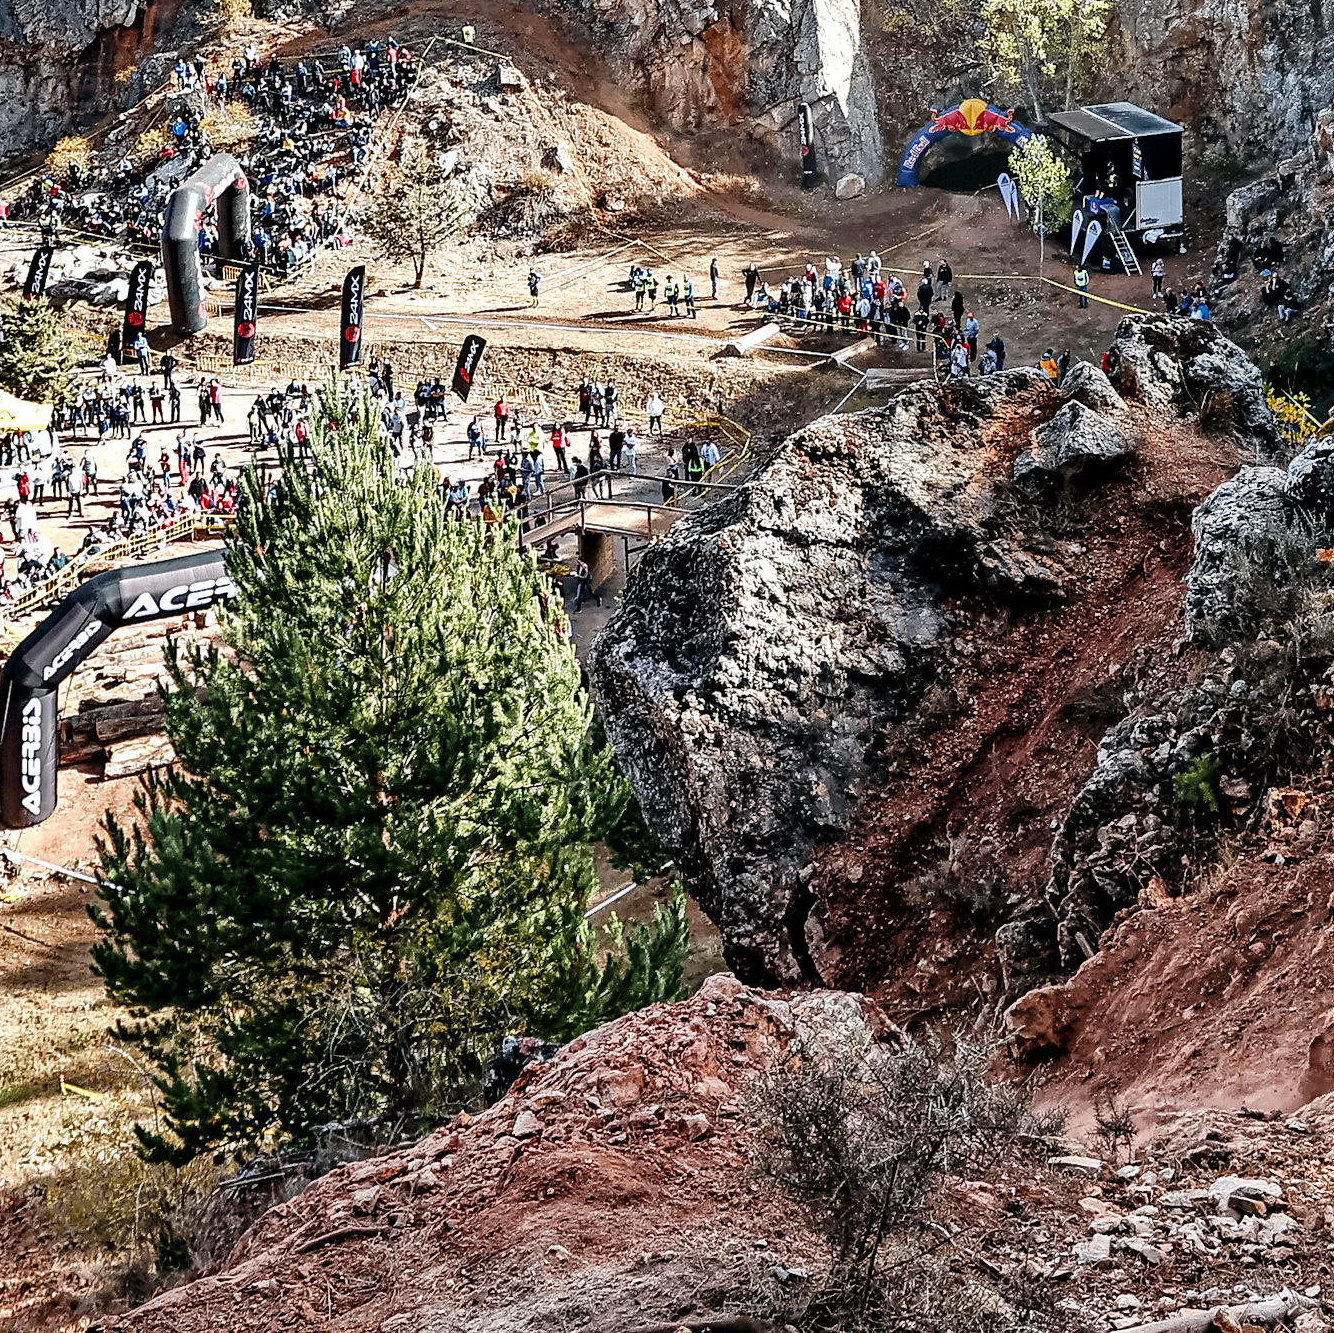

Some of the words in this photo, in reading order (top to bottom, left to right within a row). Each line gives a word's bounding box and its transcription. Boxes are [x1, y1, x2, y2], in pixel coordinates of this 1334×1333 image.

[31, 251, 49, 293] 24MX
[133, 267, 147, 312] 24MX
[242, 271, 254, 321] 24MX
[349, 274, 360, 325] 24MX
[122, 576, 238, 620] ACER
[43, 620, 103, 682] ACERBIS
[21, 697, 42, 816] ACERBIS
